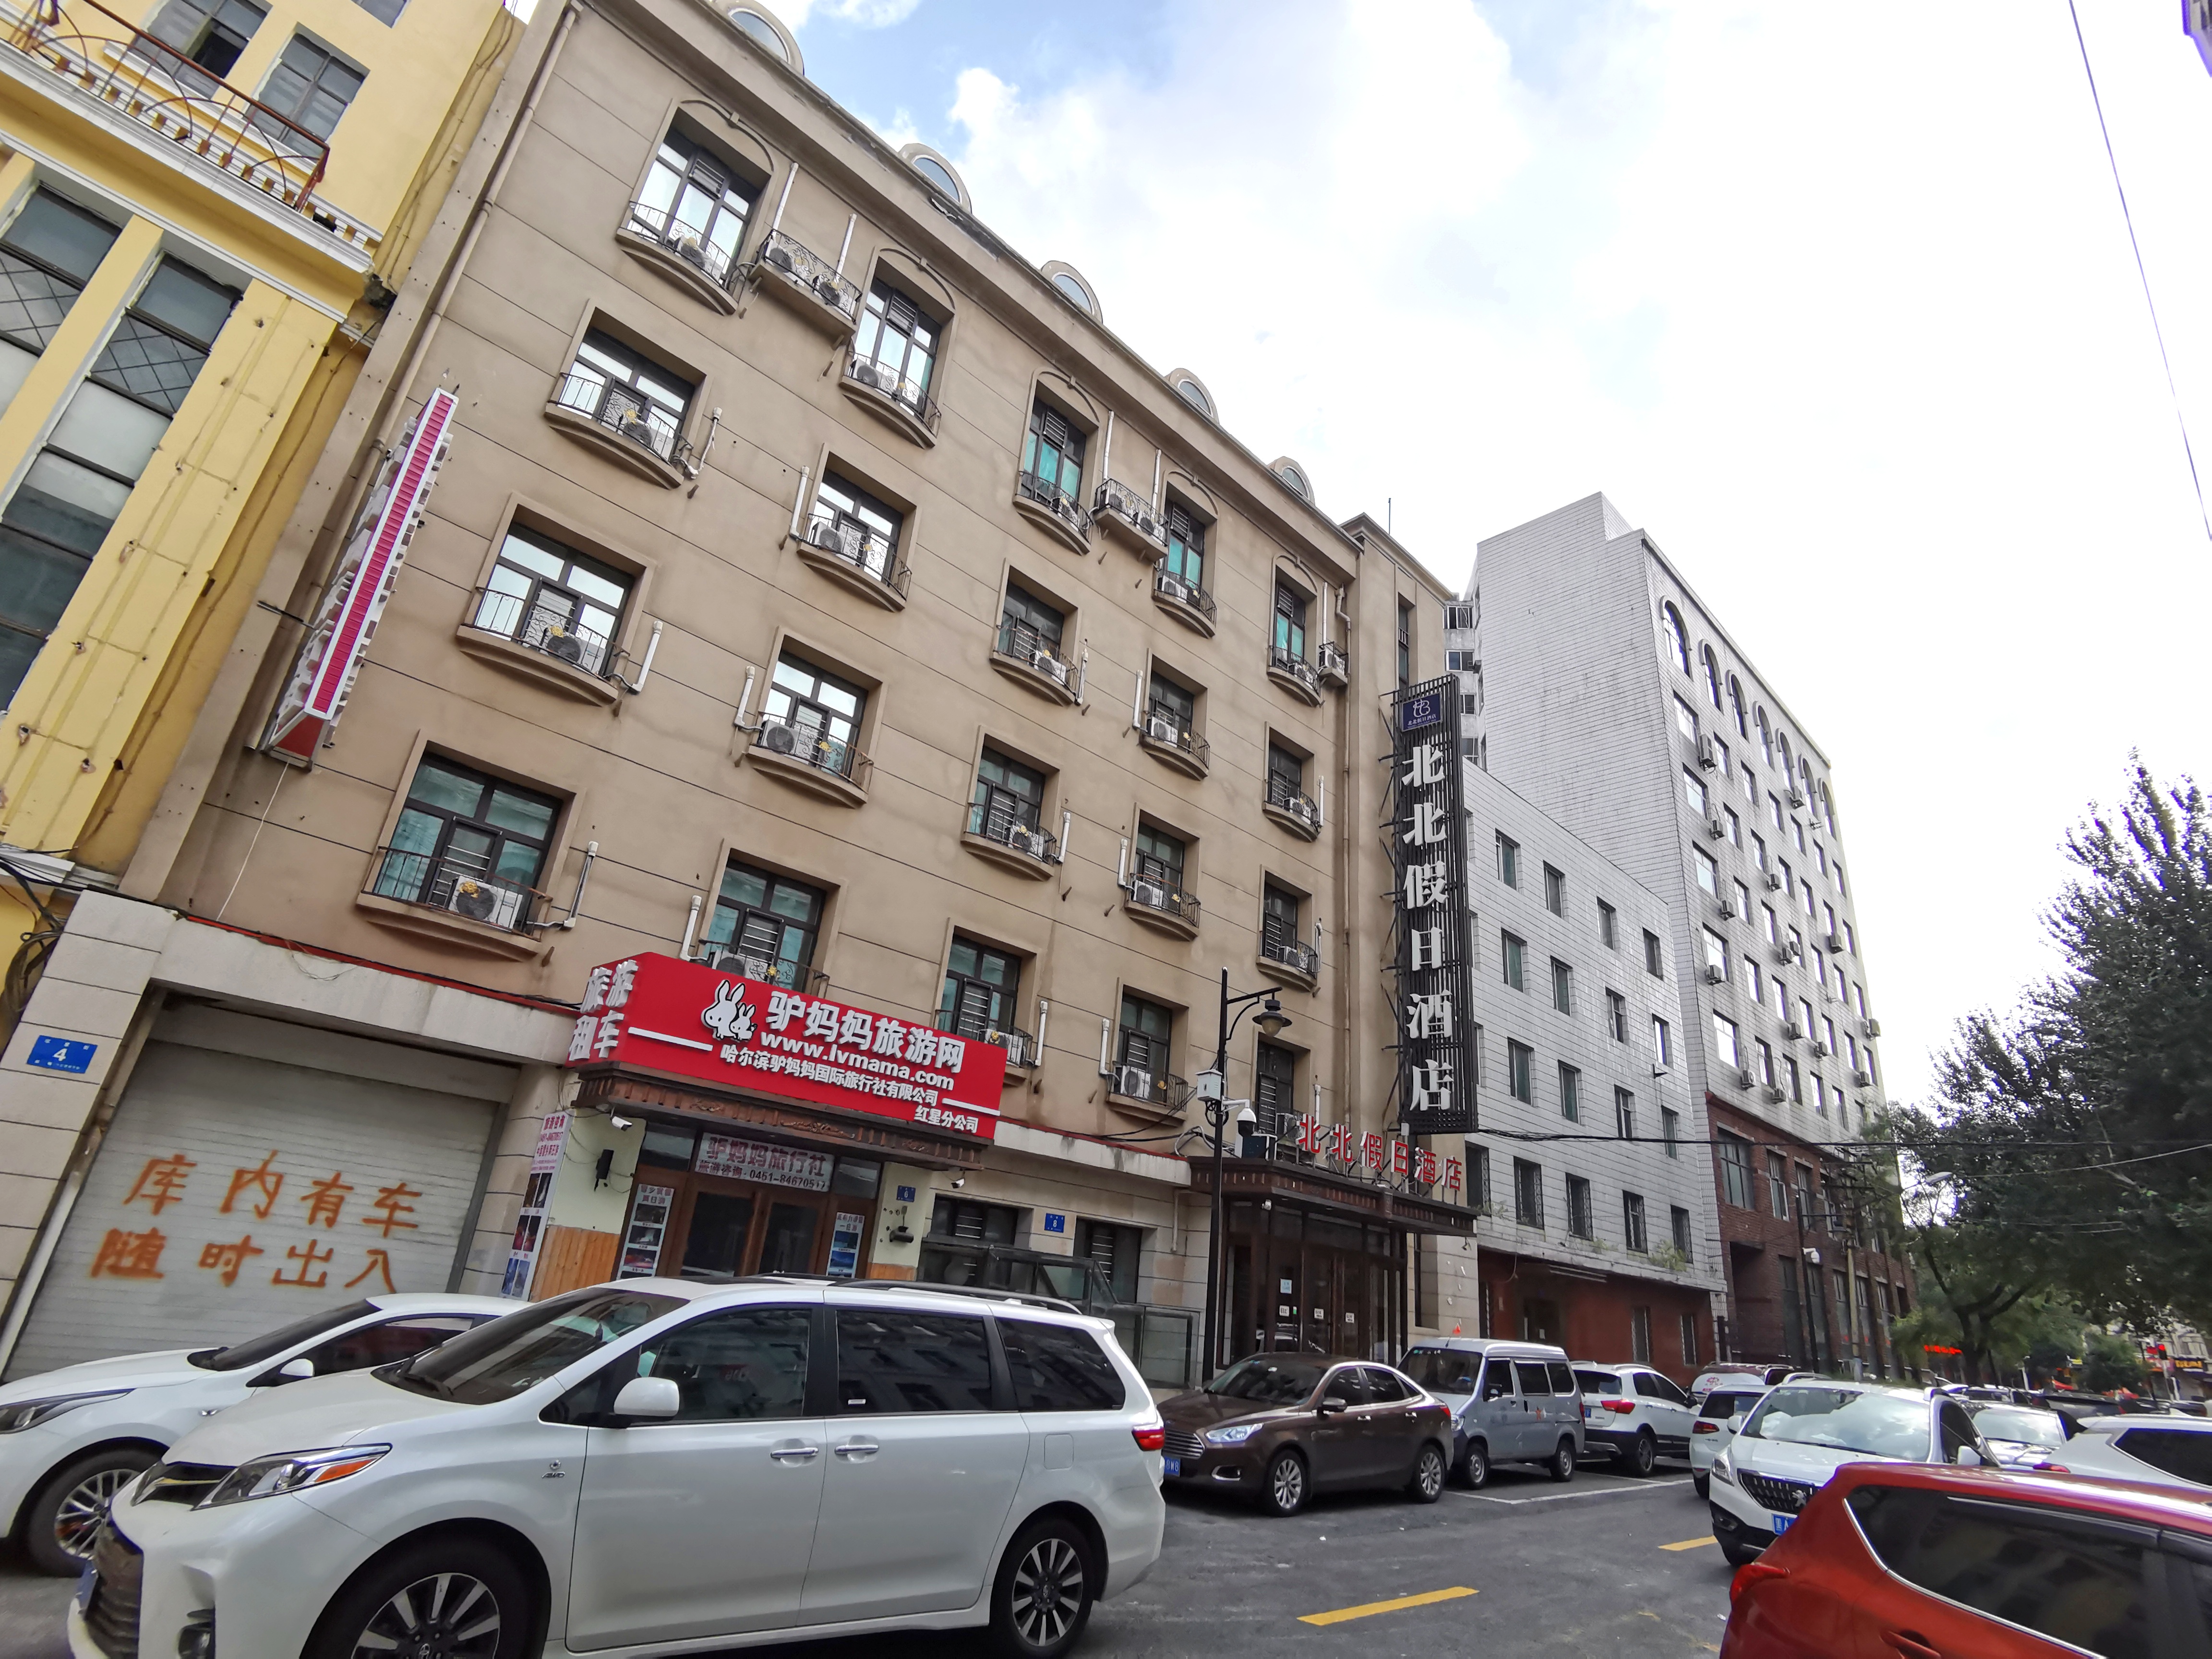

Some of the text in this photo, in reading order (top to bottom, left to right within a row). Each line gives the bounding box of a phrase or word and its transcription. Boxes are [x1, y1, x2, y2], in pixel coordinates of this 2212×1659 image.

[1401, 744, 1455, 1111] 北北假日酒店
[580, 959, 639, 1014] 旅游
[52, 1048, 67, 1061] 4
[568, 1010, 625, 1061] 租车
[760, 1031, 954, 1091] www.lvmama.com
[765, 990, 965, 1073] 驴妈妈旅游网
[720, 1044, 938, 1106] 哈尔滨驴妈妈国际旅行社有限公司
[914, 1105, 979, 1133] 红星分公司
[706, 1136, 826, 1176] 驴妈妈旅行社
[1296, 1113, 1462, 1191] 北北假日酒店
[123, 1150, 422, 1238] 库内有车
[1053, 1219, 1057, 1227] 8
[91, 1227, 397, 1294] 随时出入
